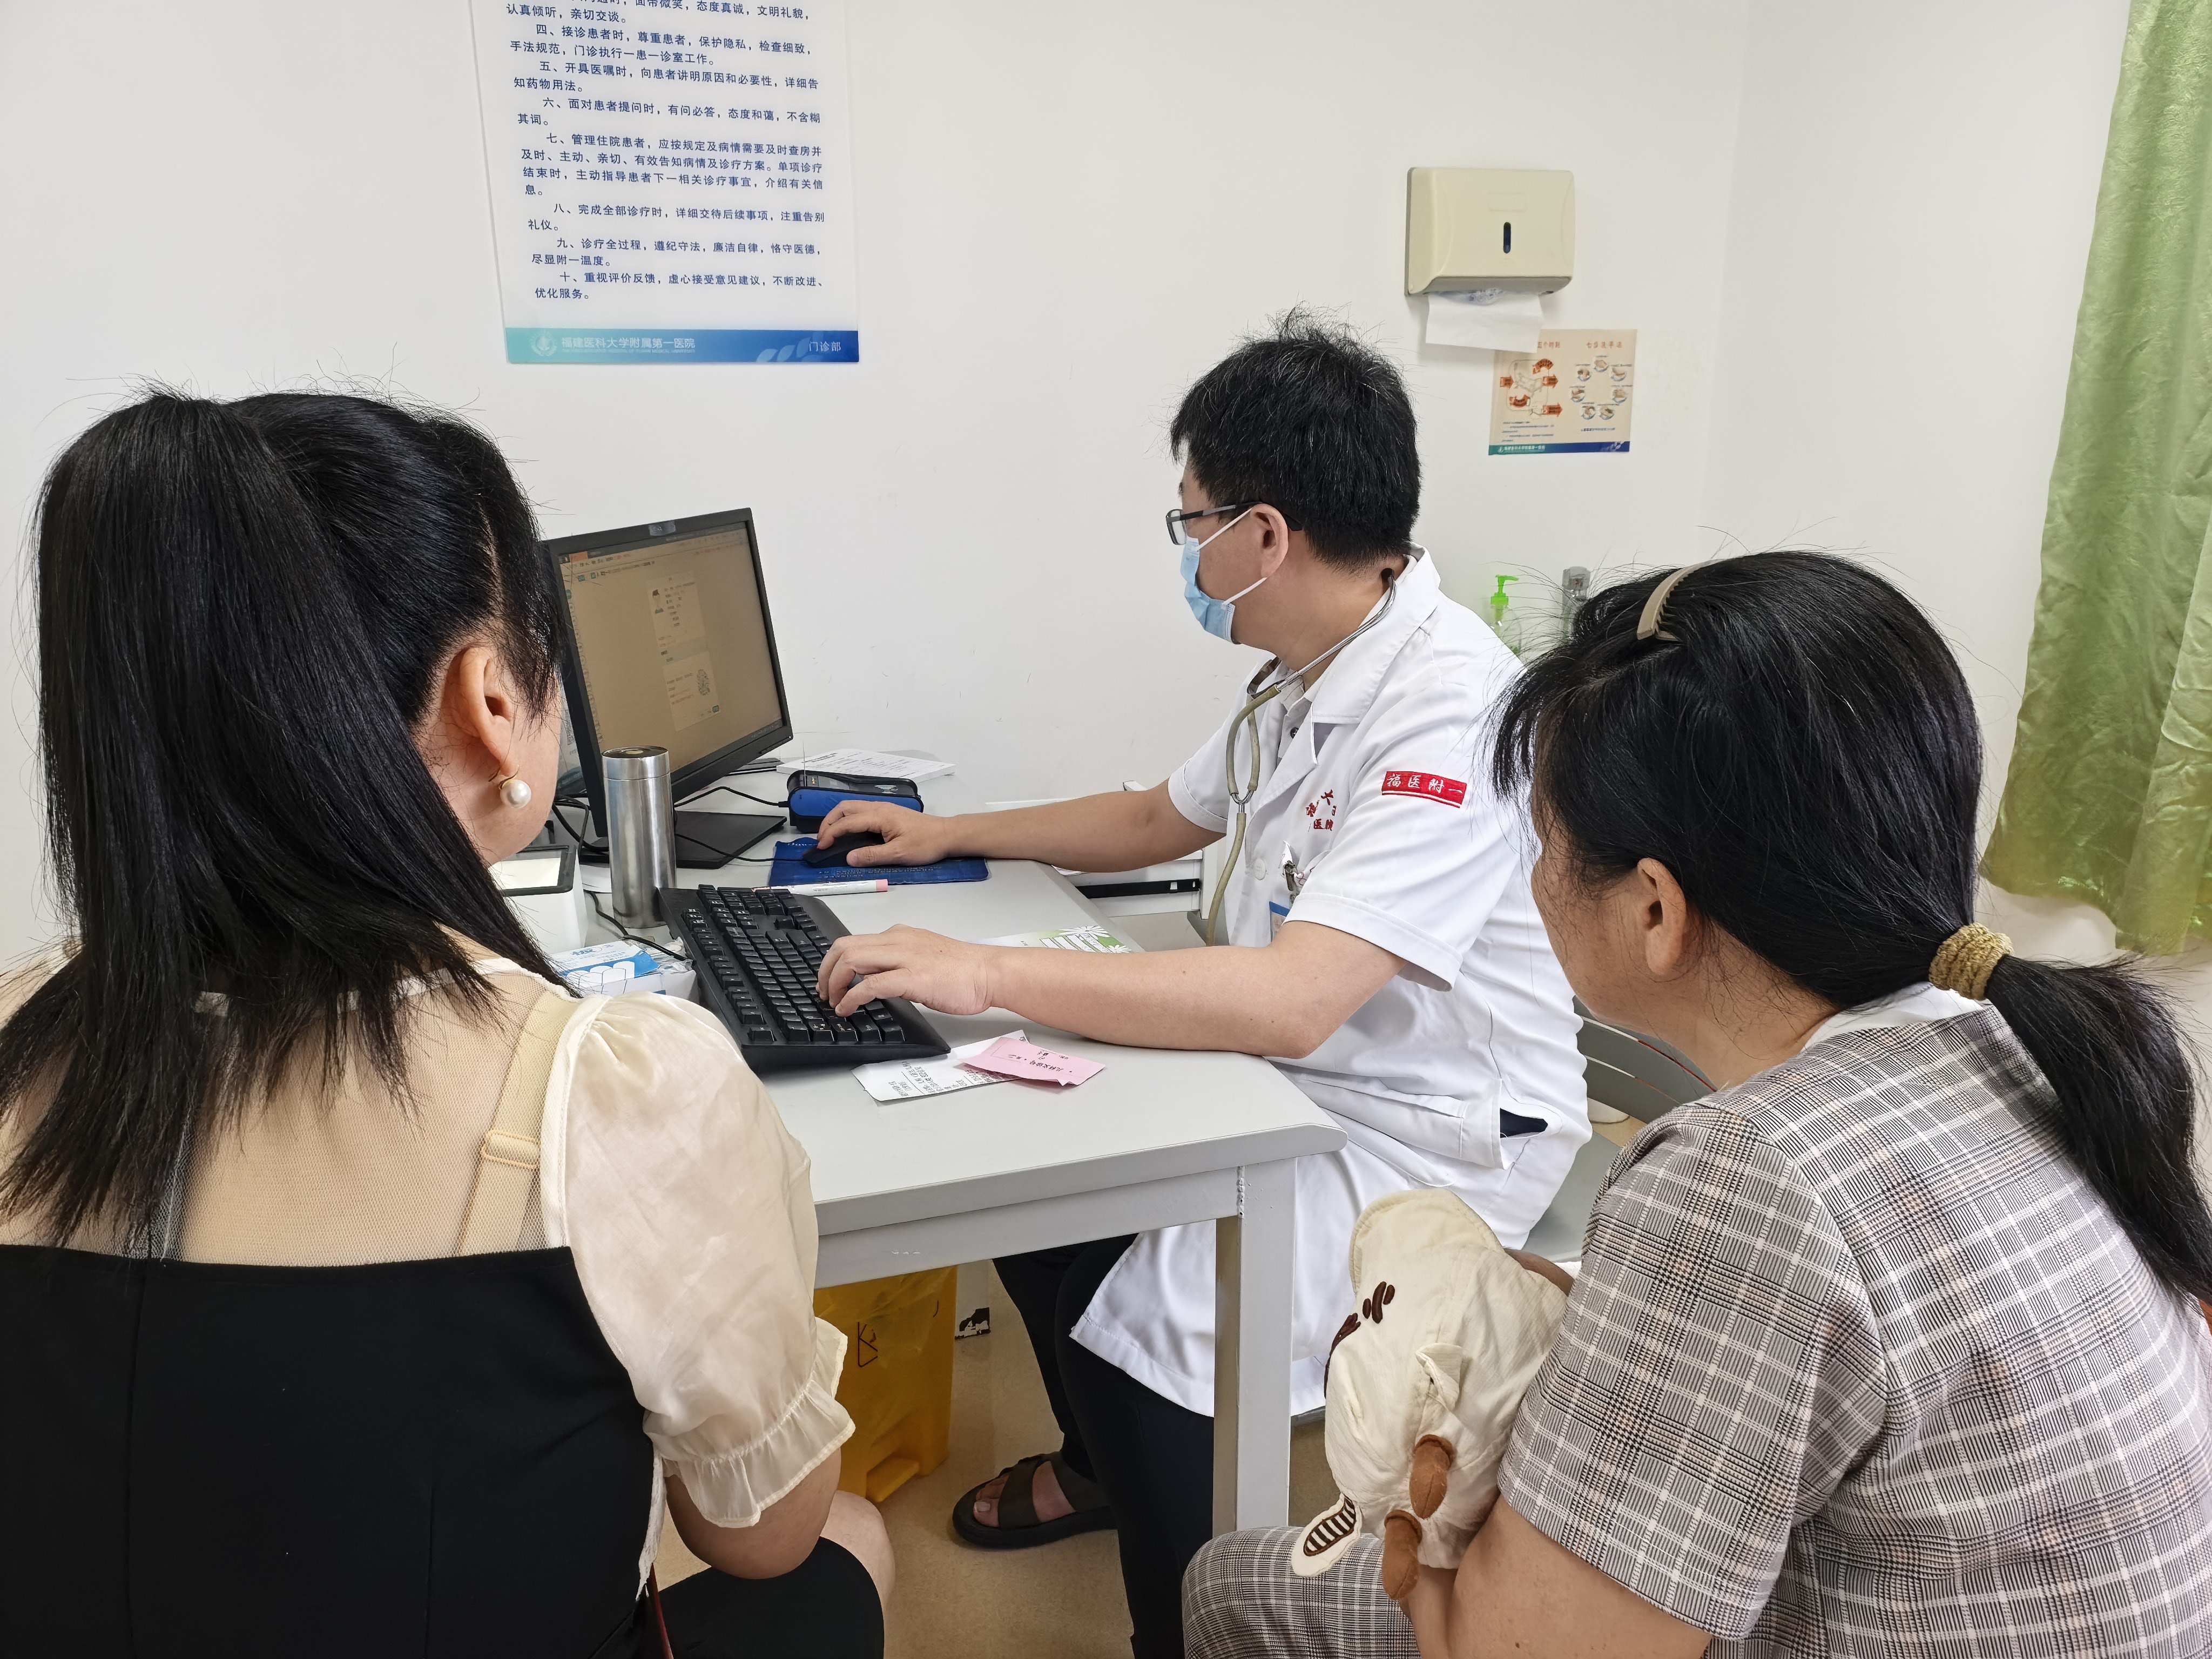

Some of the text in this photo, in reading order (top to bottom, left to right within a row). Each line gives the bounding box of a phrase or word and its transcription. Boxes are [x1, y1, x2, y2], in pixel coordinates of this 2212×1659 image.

[809, 341, 841, 352] 门诊部
[1386, 773, 1464, 794] 福医附一
